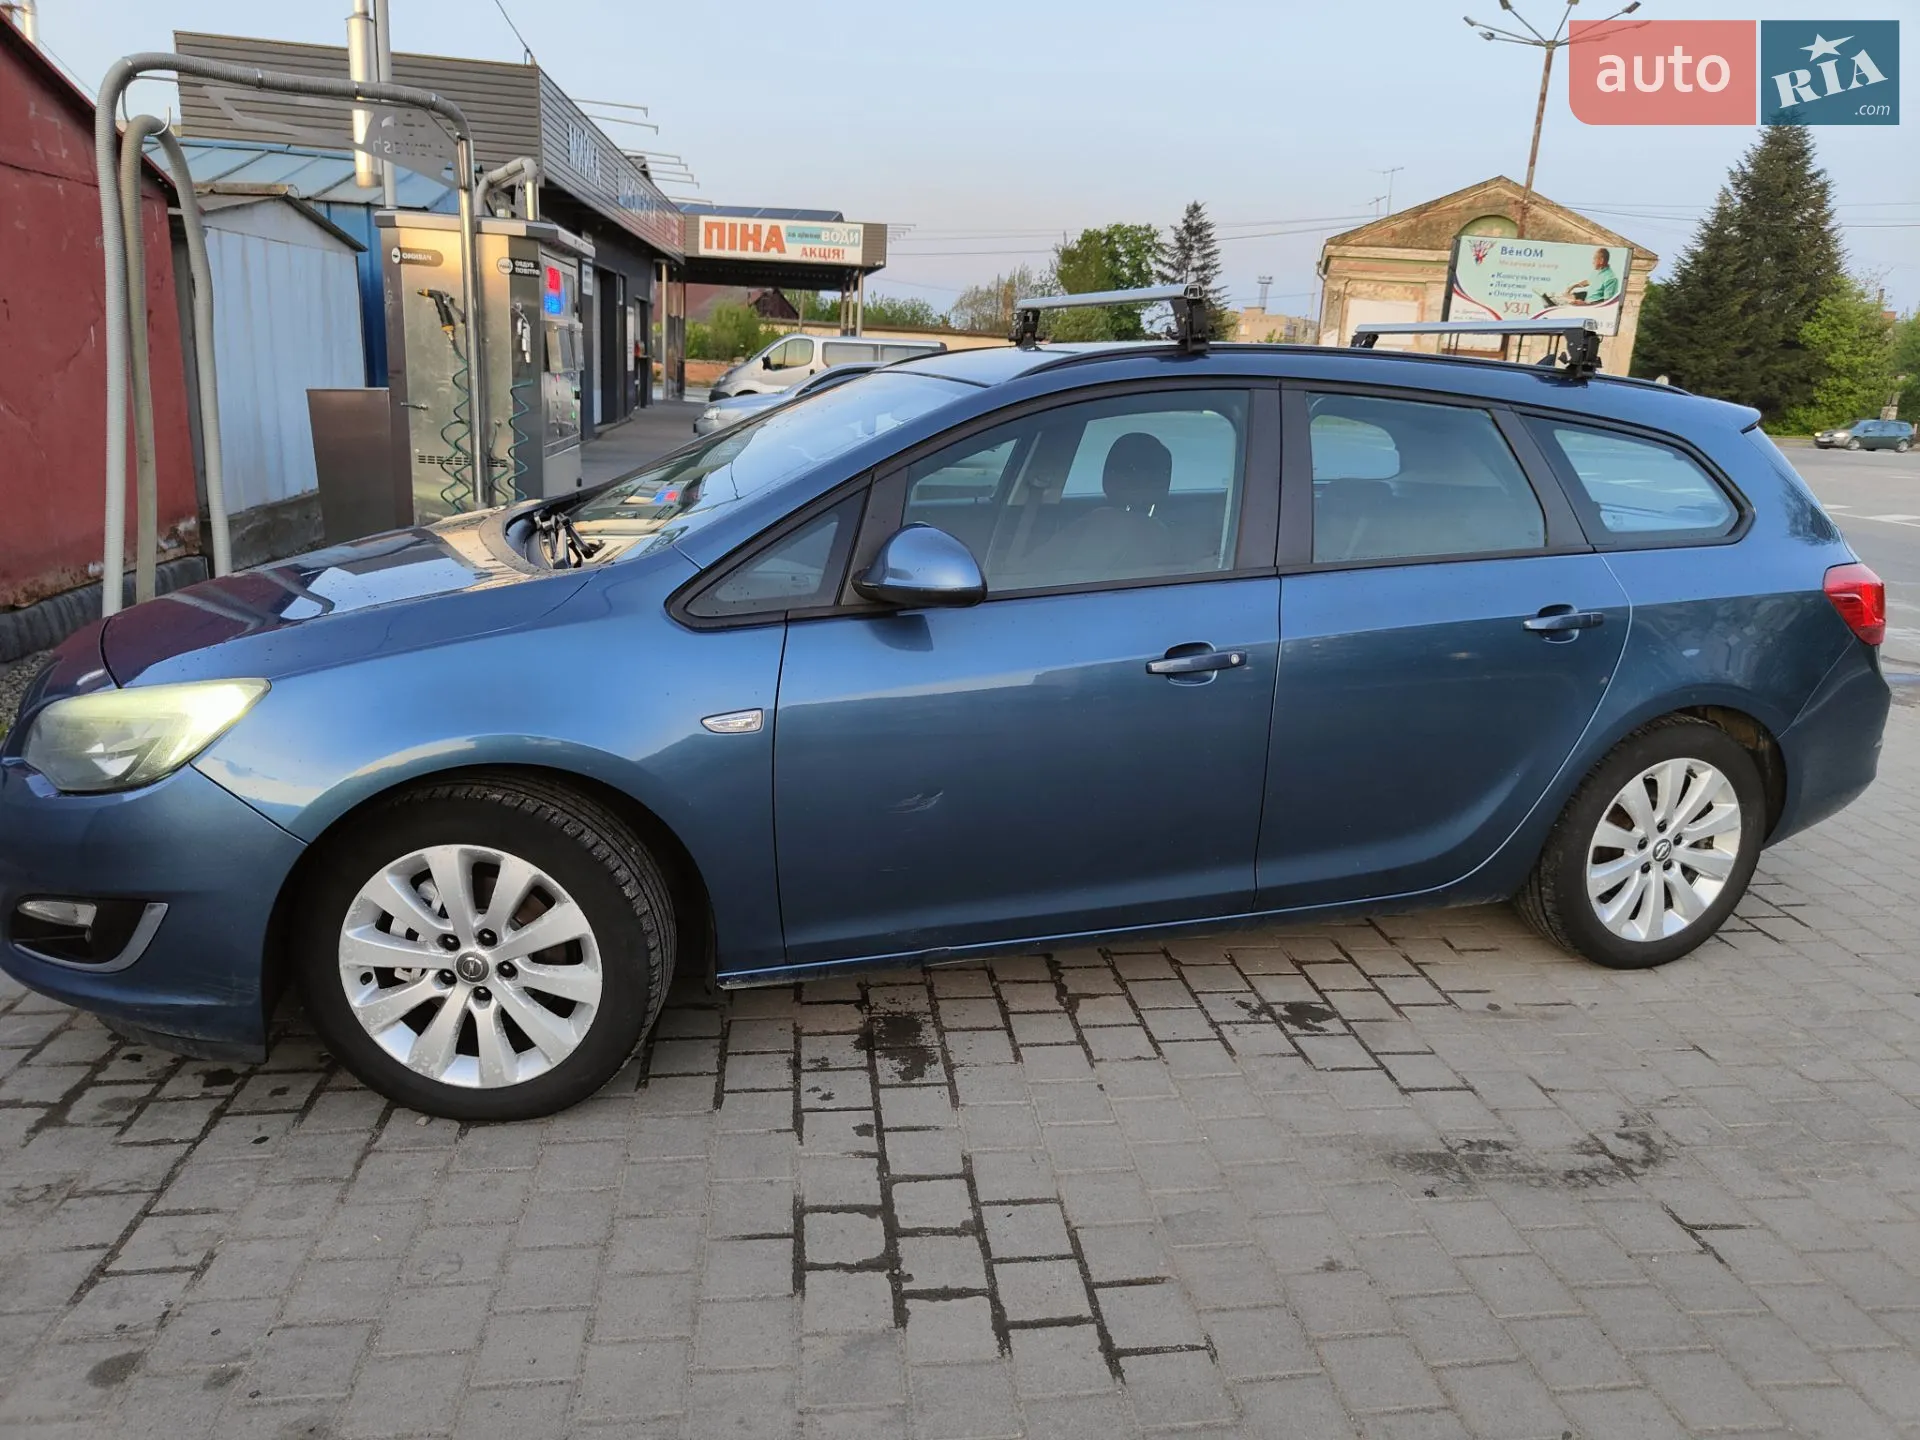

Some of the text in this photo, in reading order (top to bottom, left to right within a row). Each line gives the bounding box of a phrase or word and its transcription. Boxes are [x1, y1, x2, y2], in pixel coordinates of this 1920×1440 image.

[704, 220, 787, 254] ПІНА
[821, 230, 859, 245] ВОДИ
[800, 247, 845, 260] АКЦІЯ!
[1502, 301, 1531, 316] УЗД
